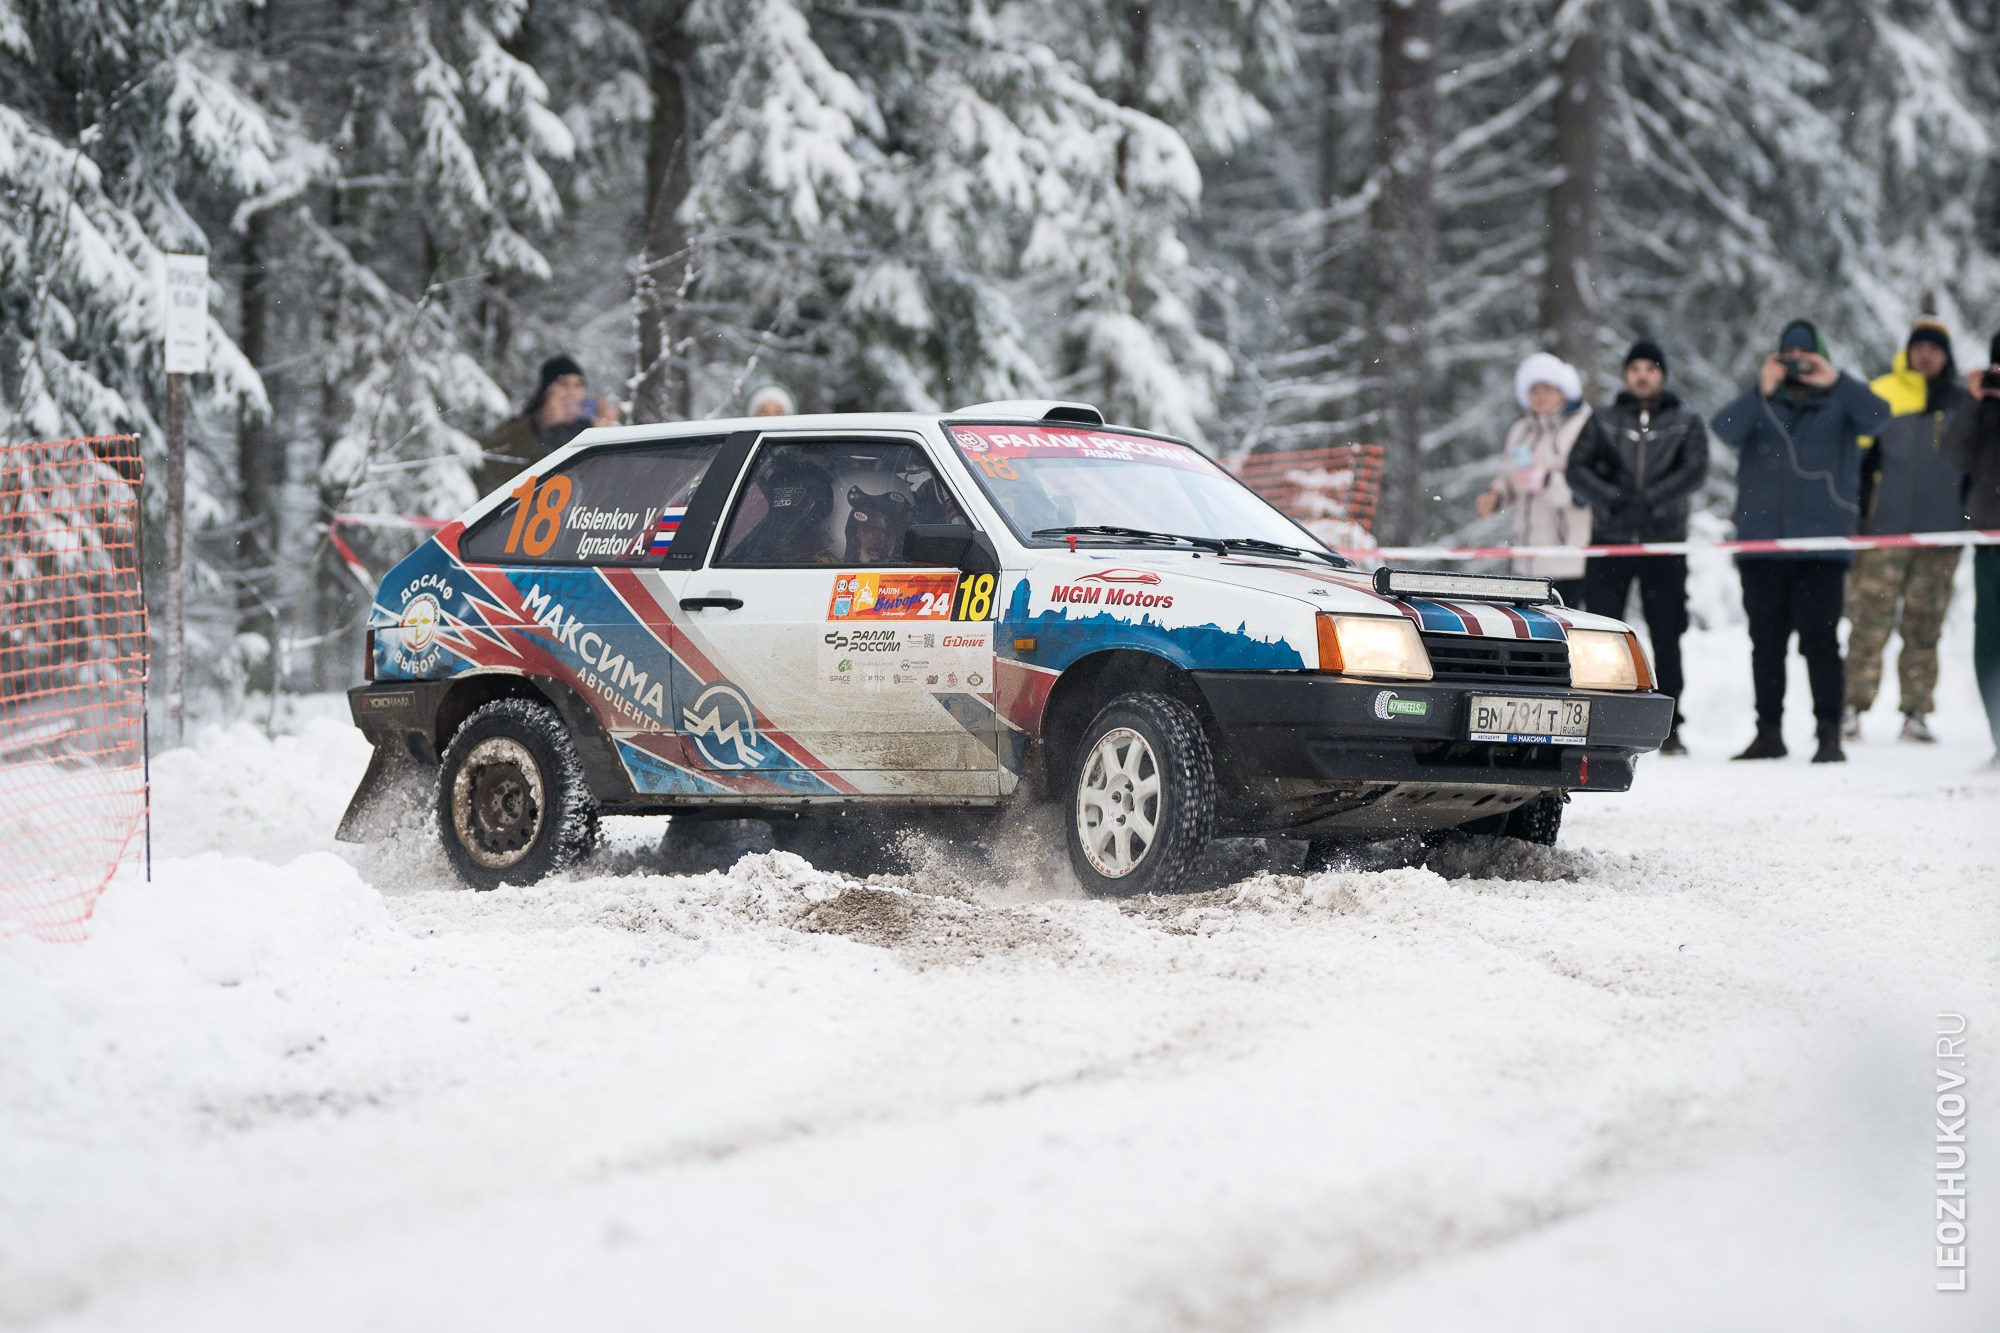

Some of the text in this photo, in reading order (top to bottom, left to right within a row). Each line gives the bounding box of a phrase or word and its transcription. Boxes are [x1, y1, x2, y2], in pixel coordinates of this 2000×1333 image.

[988, 434, 1089, 448] РАЛЛИ
[970, 452, 1020, 481] 18
[504, 475, 573, 557] 18
[565, 506, 657, 531] Kislenkov V.
[576, 531, 646, 560] Ignatov A.
[401, 574, 453, 604] ДОСААФ
[878, 587, 900, 595] РАЛЛИ
[958, 573, 995, 621] 18
[1050, 585, 1174, 608] MGM Motors
[916, 592, 950, 616] 24
[848, 641, 901, 652] РОССИИ
[851, 630, 896, 640] РАЛЛИ
[394, 645, 442, 674] ВЫБОРГ
[520, 583, 664, 718] МАКСИМА
[369, 697, 411, 708] YOKOHAMA
[576, 667, 661, 733] АВТОЦЕНТР
[1566, 703, 1582, 725] 78
[1518, 735, 1547, 743] МАКСИМА
[1562, 726, 1576, 735] RUS
